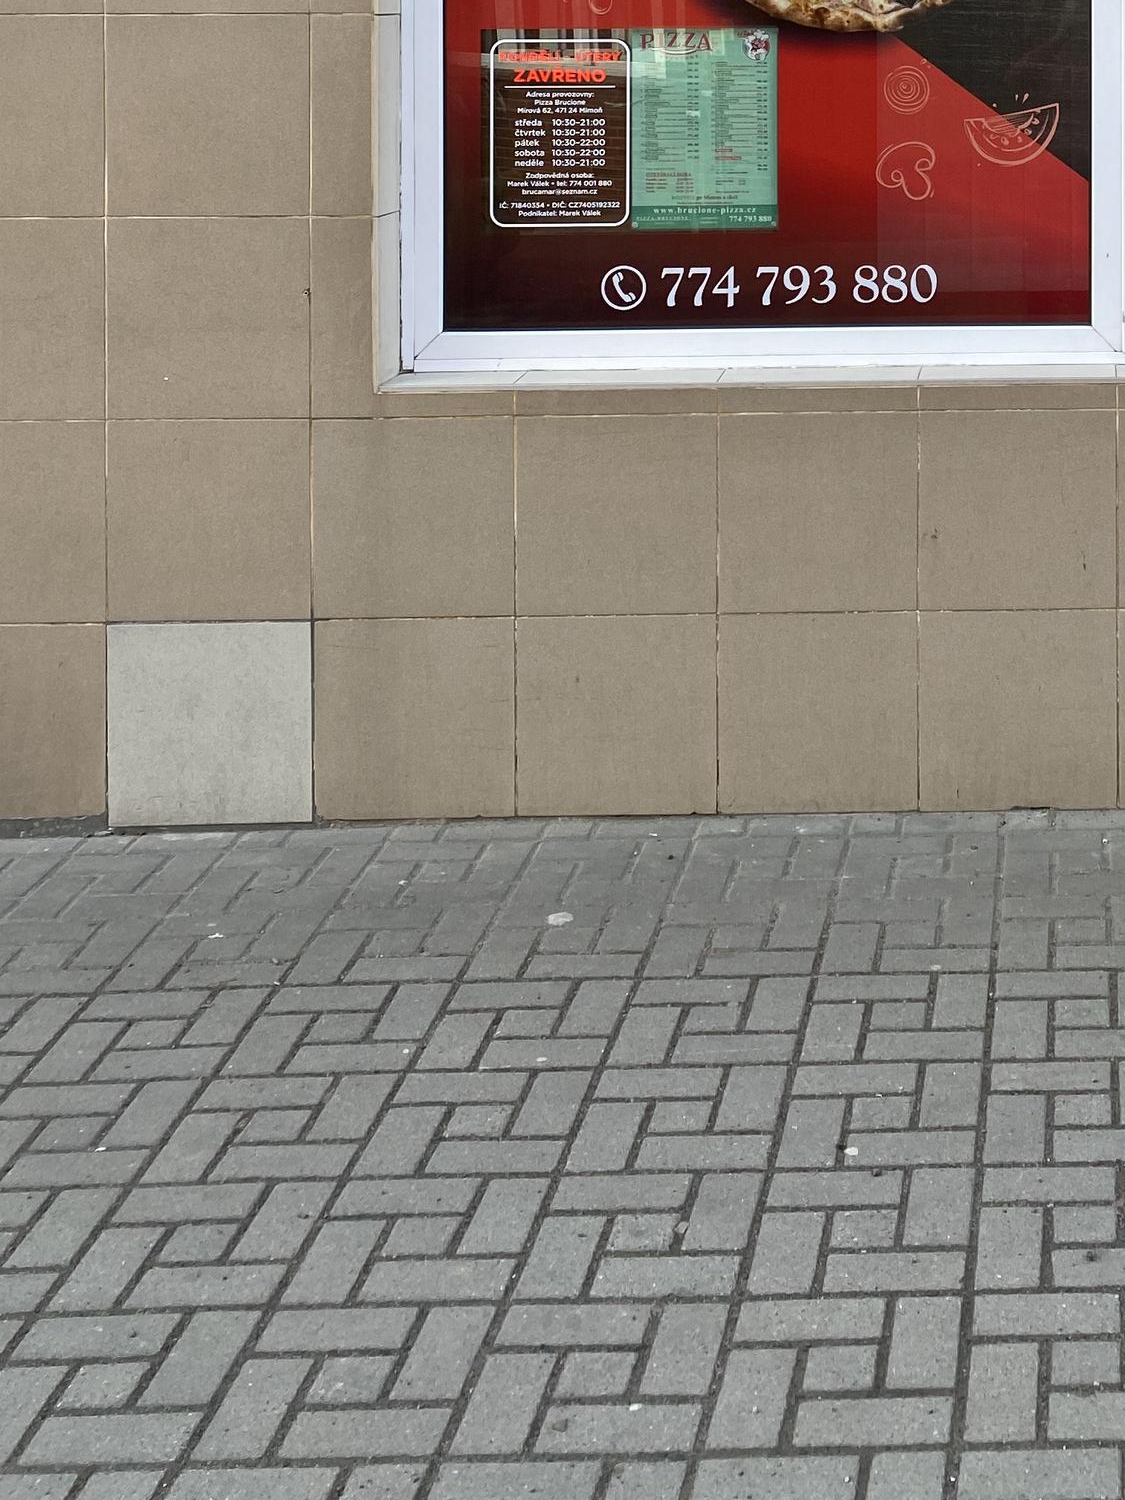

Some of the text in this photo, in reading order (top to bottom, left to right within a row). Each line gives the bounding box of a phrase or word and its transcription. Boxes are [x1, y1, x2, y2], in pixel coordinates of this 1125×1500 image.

[639, 32, 713, 52] PIZZA
[513, 64, 607, 83] ZAVŘENO
[514, 118, 543, 127] středa
[514, 128, 546, 137] čtvrtek
[514, 139, 540, 148] pátek
[514, 149, 545, 157] sobota
[514, 159, 544, 167] neděle
[653, 206, 757, 215] www.brucione-pizza.cz
[661, 264, 938, 308] 774 793 880
